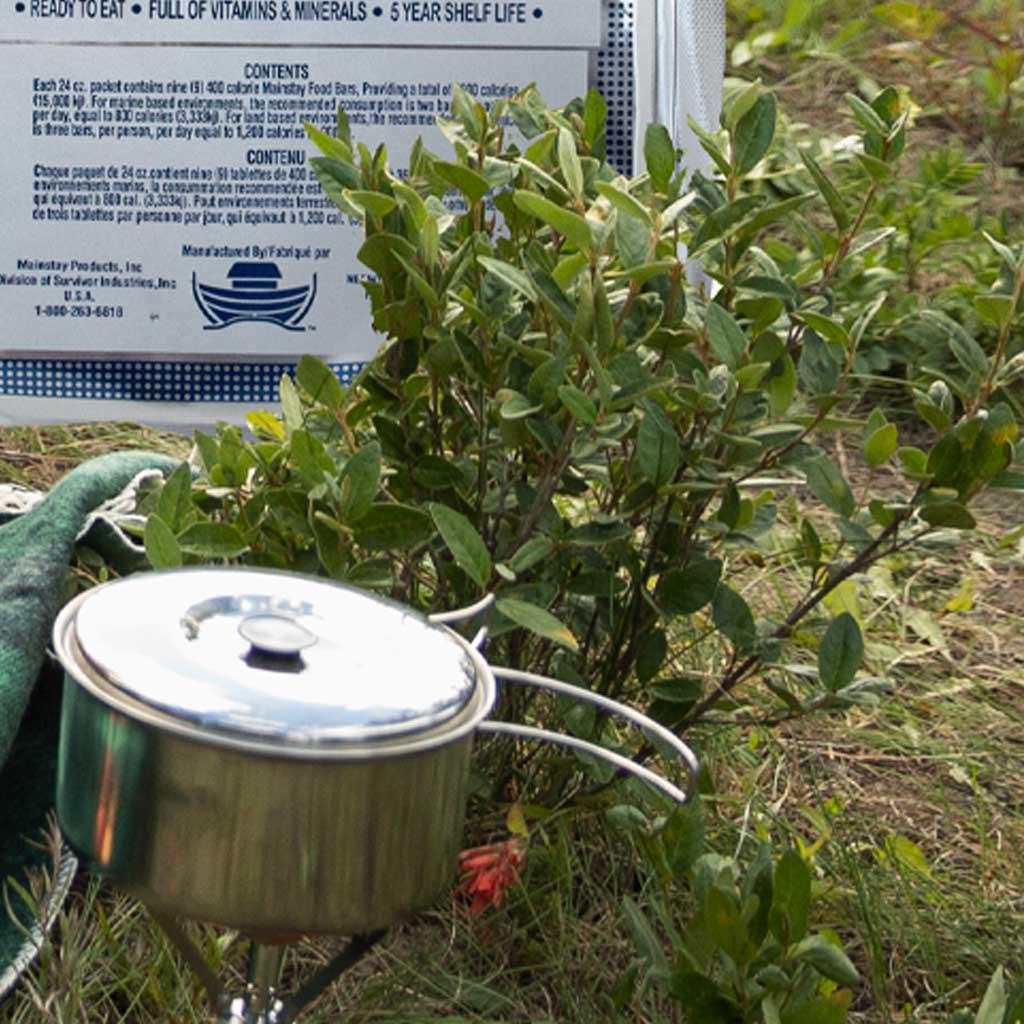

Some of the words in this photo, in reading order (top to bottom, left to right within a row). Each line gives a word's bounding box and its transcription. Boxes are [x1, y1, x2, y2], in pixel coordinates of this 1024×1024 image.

[149, 0, 184, 19] FULL
[187, 0, 207, 19] OF
[211, 0, 278, 20] VITAMINS
[280, 0, 292, 20] &
[294, 1, 367, 21] MINERALS
[390, 1, 400, 21] 5
[402, 2, 442, 22] YEAR
[445, 2, 492, 22] SHELF
[494, 3, 527, 23] LIFE
[243, 63, 310, 79] CONTENTS
[32, 78, 57, 92] Each
[58, 78, 72, 92] 24
[90, 79, 122, 93] packet
[123, 79, 164, 93] contains
[262, 81, 306, 95] Mainstay
[307, 82, 332, 95] Food
[91, 96, 107, 109] For
[145, 97, 175, 110] based
[32, 111, 50, 124] per
[98, 125, 115, 138] per
[156, 125, 173, 138] per
[246, 149, 306, 165] CONTENU
[32, 165, 70, 179] Chaque
[181, 245, 250, 258] Manufactured
[314, 247, 332, 260] par
[16, 260, 68, 273] Mainstay
[125, 262, 143, 275] Inc
[39, 276, 51, 287] of
[53, 276, 99, 288] Survivor
